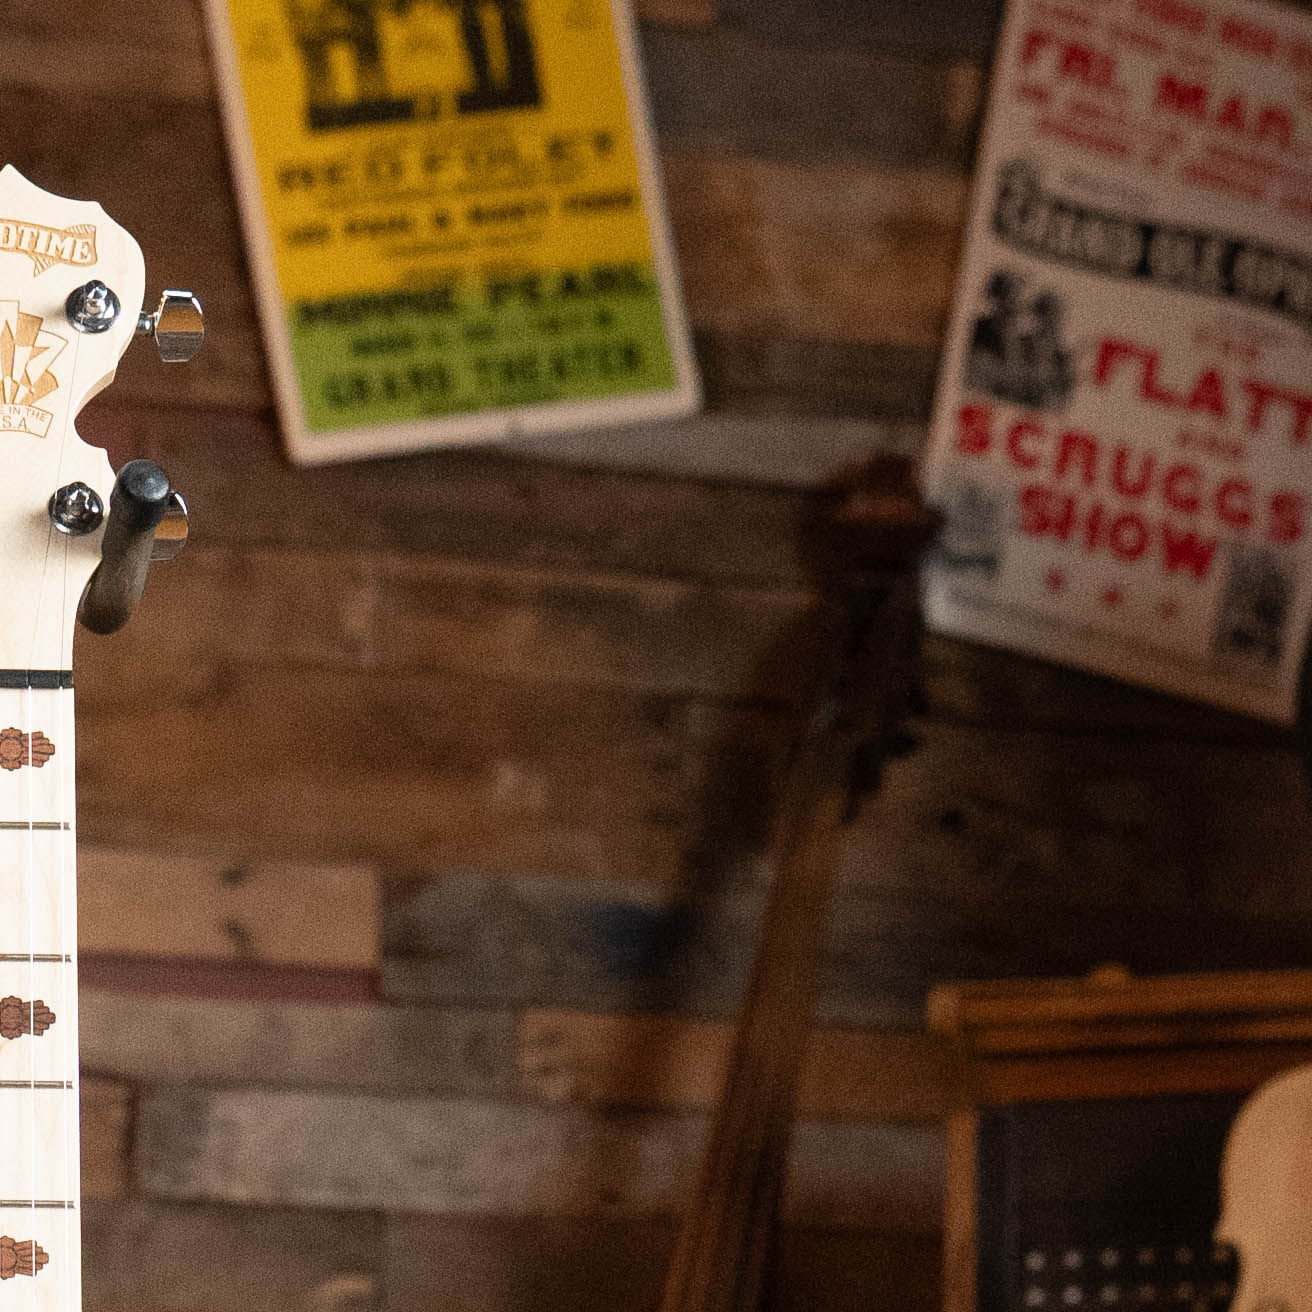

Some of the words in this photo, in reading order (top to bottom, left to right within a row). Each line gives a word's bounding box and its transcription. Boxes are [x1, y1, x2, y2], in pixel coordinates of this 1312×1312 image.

[9, 406, 21, 415] IN
[25, 407, 47, 421] THE
[957, 402, 1304, 544] SCRUGGS
[1019, 485, 1220, 580] SHOW
